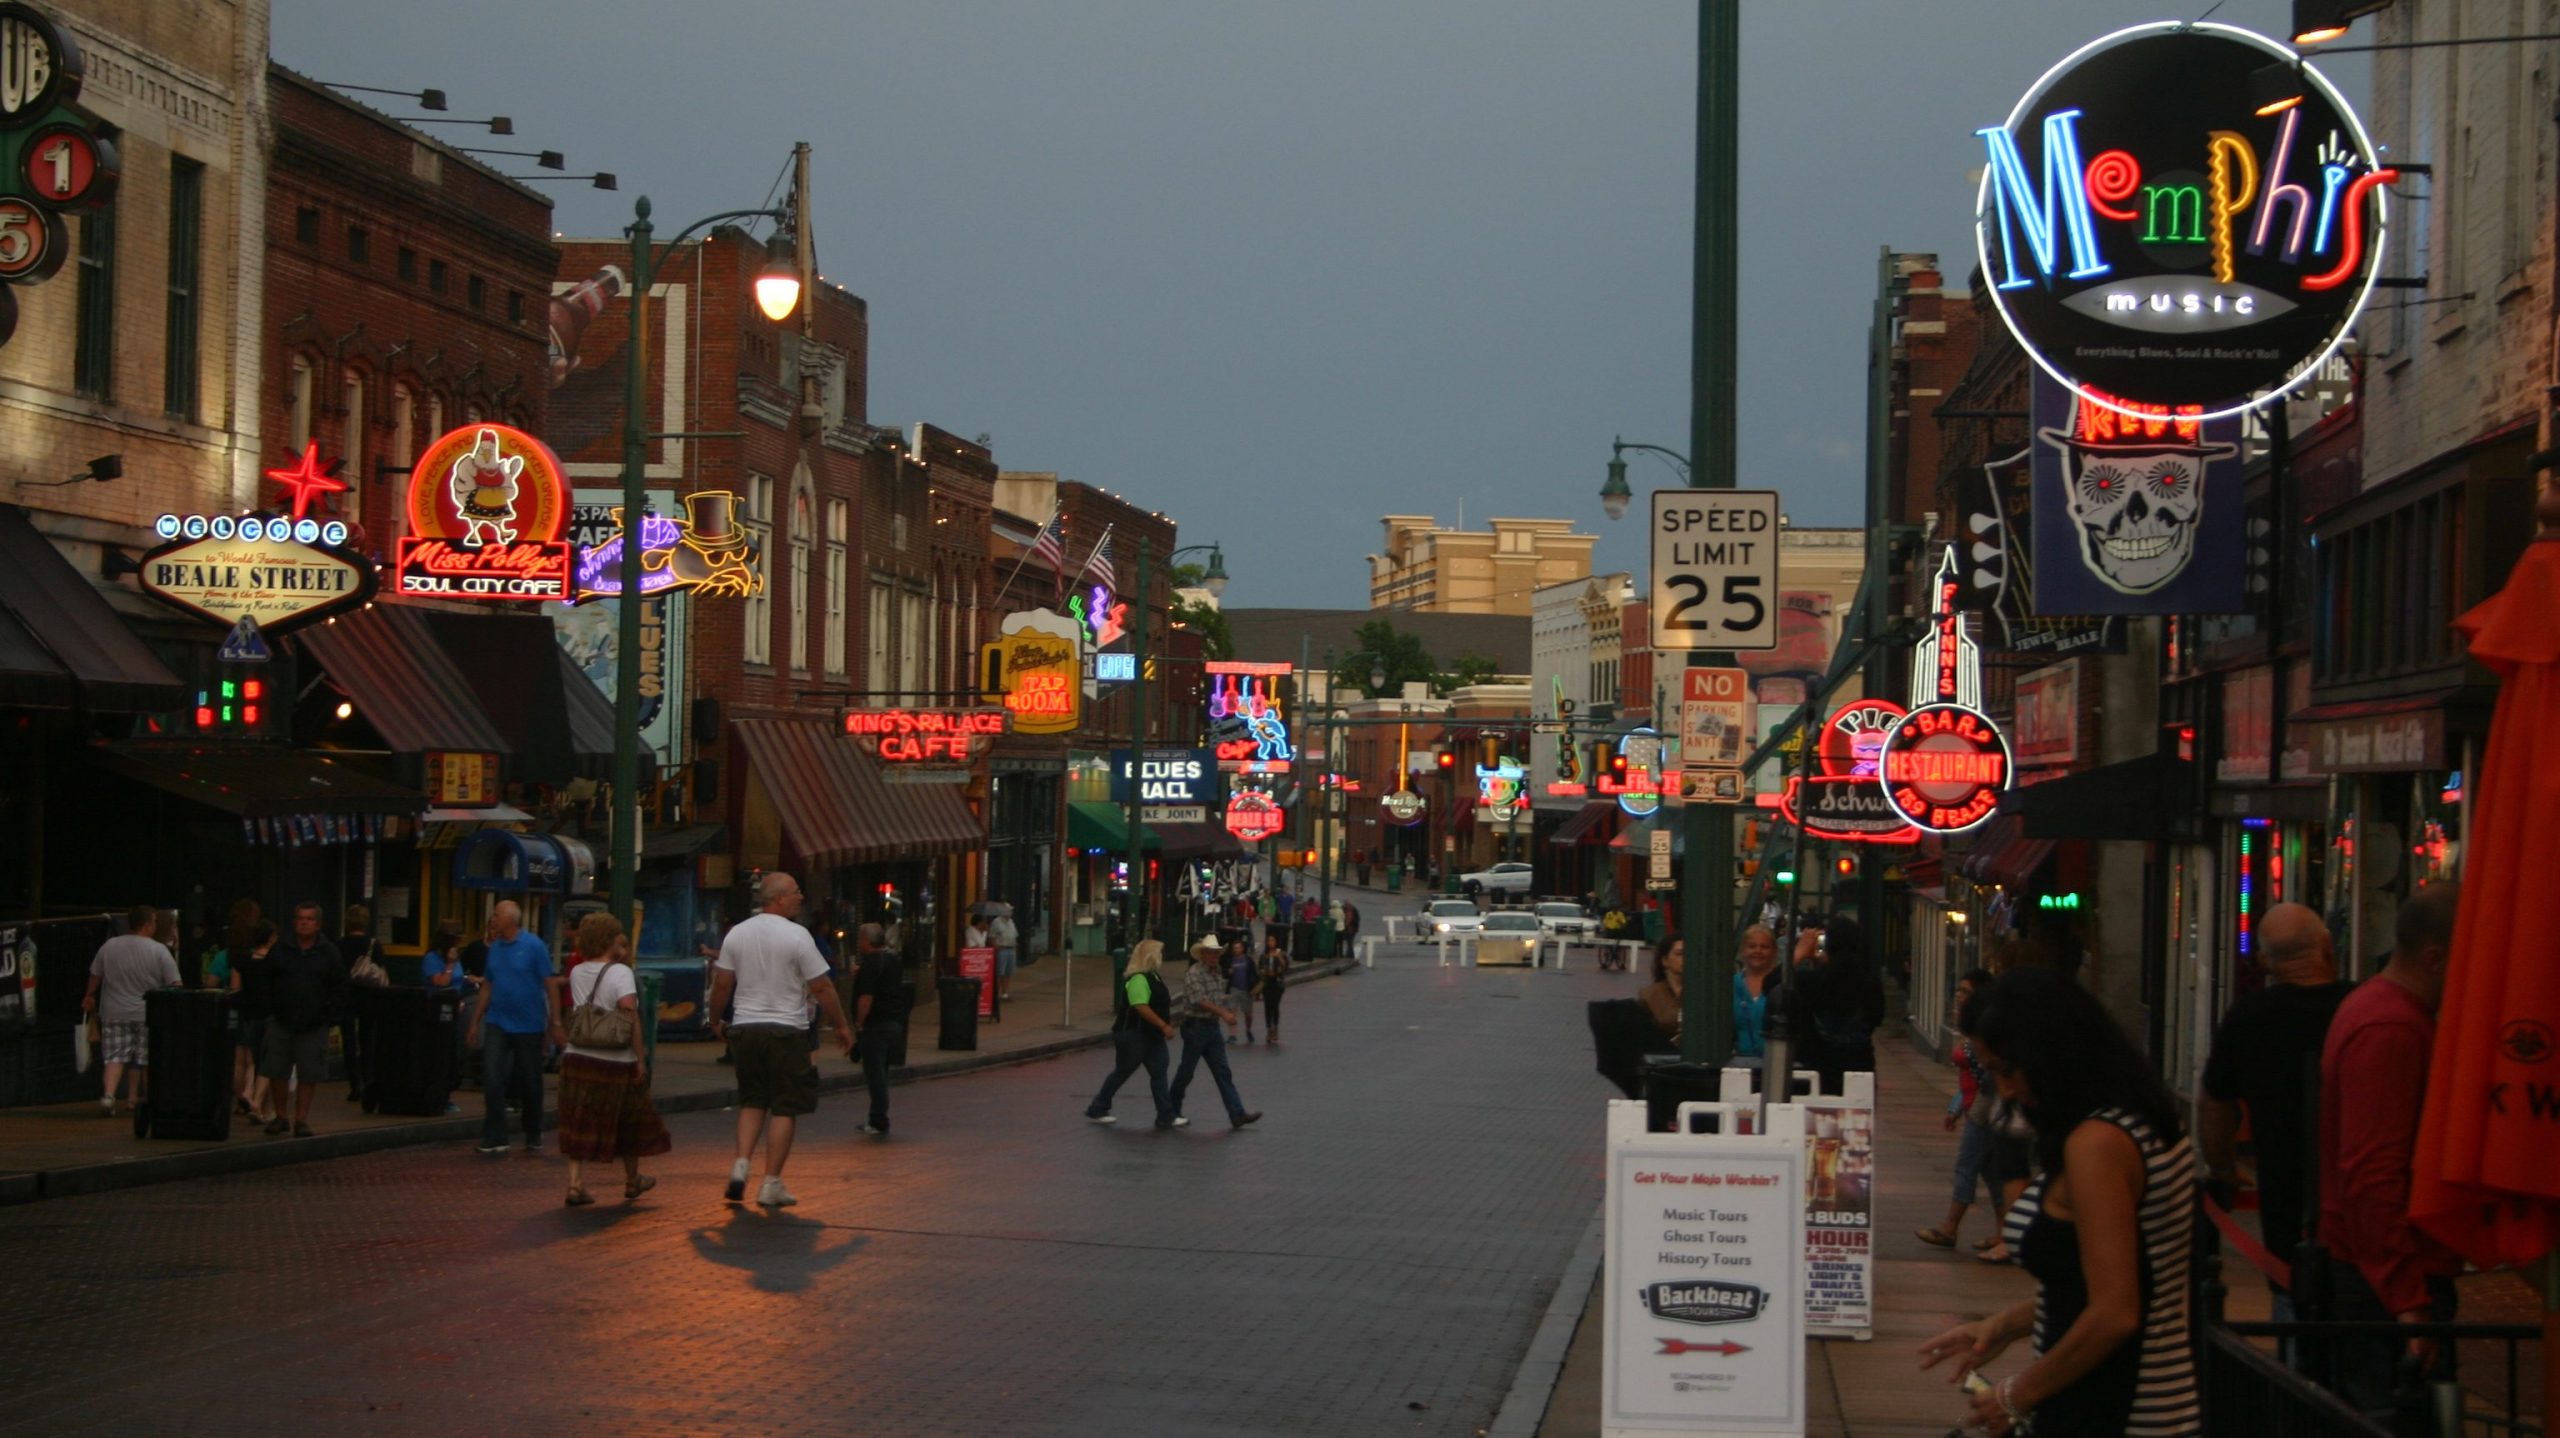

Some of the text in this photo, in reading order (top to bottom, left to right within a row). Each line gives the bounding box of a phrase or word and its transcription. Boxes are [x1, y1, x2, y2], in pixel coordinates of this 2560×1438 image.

[44, 139, 71, 194] 1
[1976, 107, 2400, 290] Memphis
[0, 213, 29, 264] 5
[2106, 294, 2254, 315] music
[2075, 347, 2136, 360] Everything
[2139, 347, 2174, 360] Blues,
[2176, 347, 2201, 358] Soul
[2202, 348, 2212, 359] &
[507, 438, 546, 481] CHICKEN
[158, 517, 347, 543] WELCOME
[1662, 509, 1768, 532] SPEED
[219, 552, 255, 564] World
[257, 553, 298, 565] Famous
[403, 541, 476, 568] Miss
[1674, 542, 1755, 565] LIMIT
[156, 564, 349, 591] BEALE STREET
[403, 576, 562, 595] SOUL CITY CAFE
[1664, 574, 1765, 632] 25
[639, 600, 662, 697] LUES
[1024, 676, 1066, 692] TAP
[1695, 674, 1732, 696] NO
[1006, 691, 1071, 712] ROOM
[1687, 704, 1737, 717] PARKING
[846, 710, 1003, 733] KING'S PALACE
[1918, 710, 1979, 738] BAR
[879, 737, 969, 759] CAFE
[1685, 735, 1719, 748] ANYT
[1887, 752, 2003, 783] RESTAURANT
[1696, 786, 1717, 794] ZON
[1819, 782, 1893, 812] Schw
[1167, 809, 1198, 819] JOINT
[1895, 787, 1998, 828] 159 BEALE
[1634, 1172, 1657, 1183] Get
[1660, 1172, 1689, 1184] Your
[1691, 1173, 1721, 1186] Mojo
[1663, 1209, 1748, 1222] Music Tours
[1814, 1210, 1868, 1225] BUDS
[1664, 1229, 1747, 1243] Ghost Tours
[1807, 1230, 1869, 1247] HOUR
[1658, 1252, 1752, 1269] History Tours
[1812, 1263, 1863, 1272] DRINKS
[1809, 1272, 1846, 1280] LIGHT
[1811, 1281, 1863, 1290] DRAFTS
[1658, 1285, 1754, 1308] Backbeat
